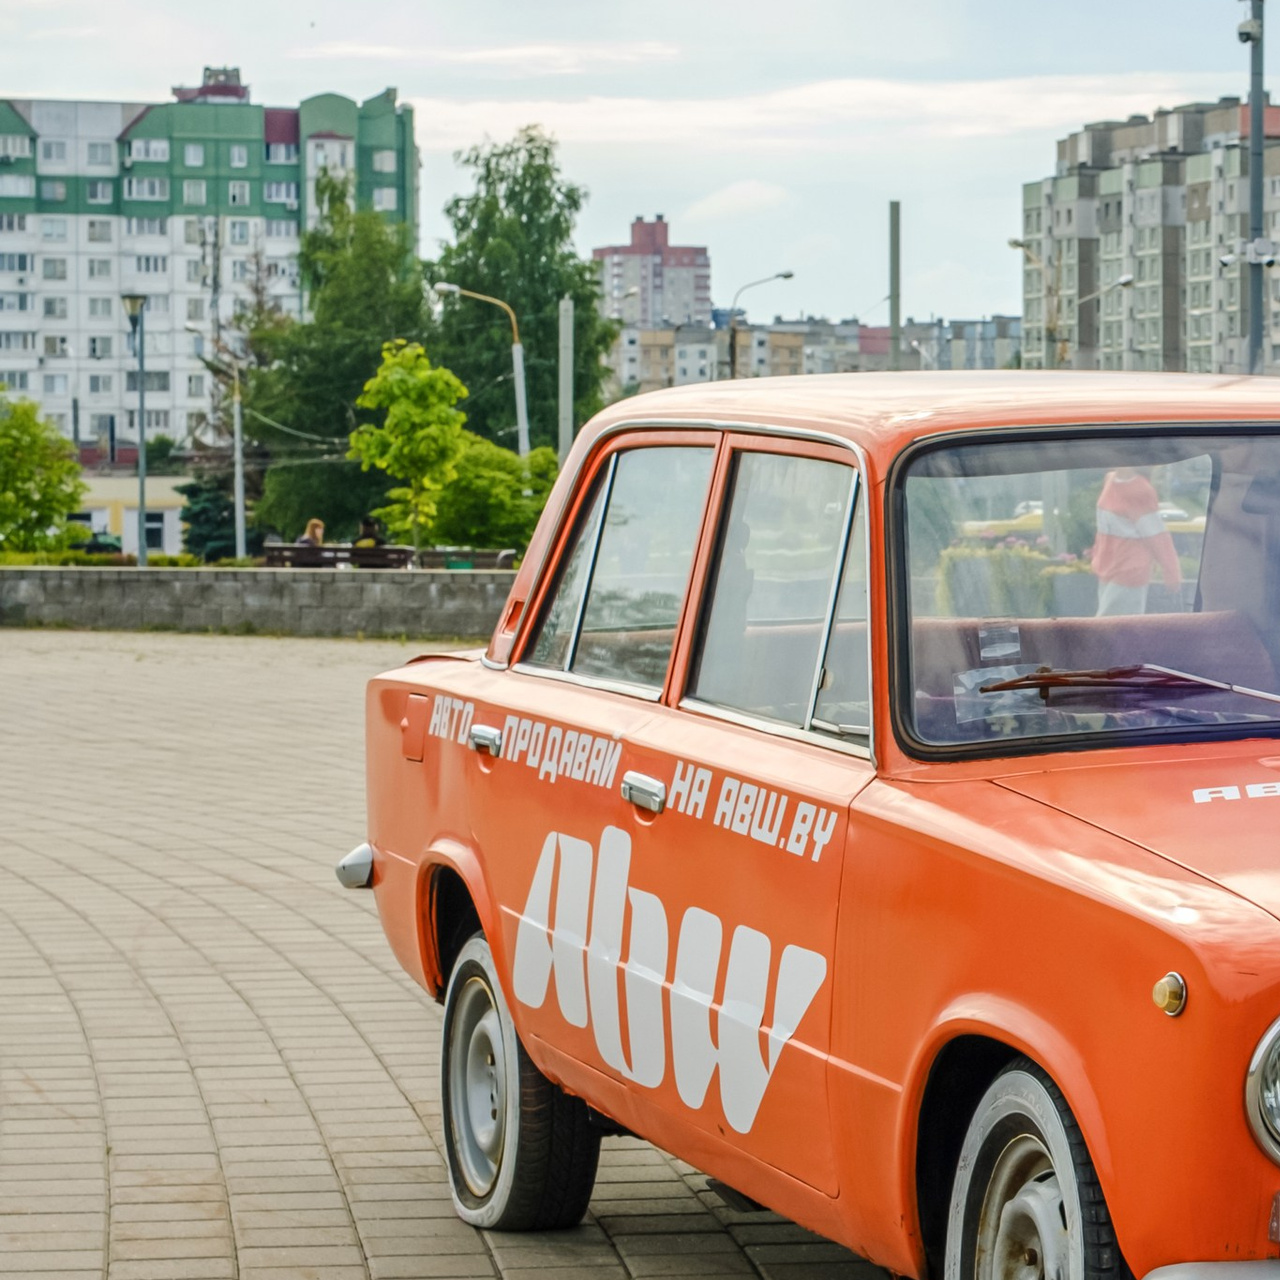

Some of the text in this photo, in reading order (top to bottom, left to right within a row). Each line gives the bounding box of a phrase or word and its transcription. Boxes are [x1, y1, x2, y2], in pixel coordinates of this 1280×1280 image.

[428, 694, 475, 750] АВТО
[499, 715, 625, 789] ПРОДАВАЙ
[666, 760, 713, 819] НА
